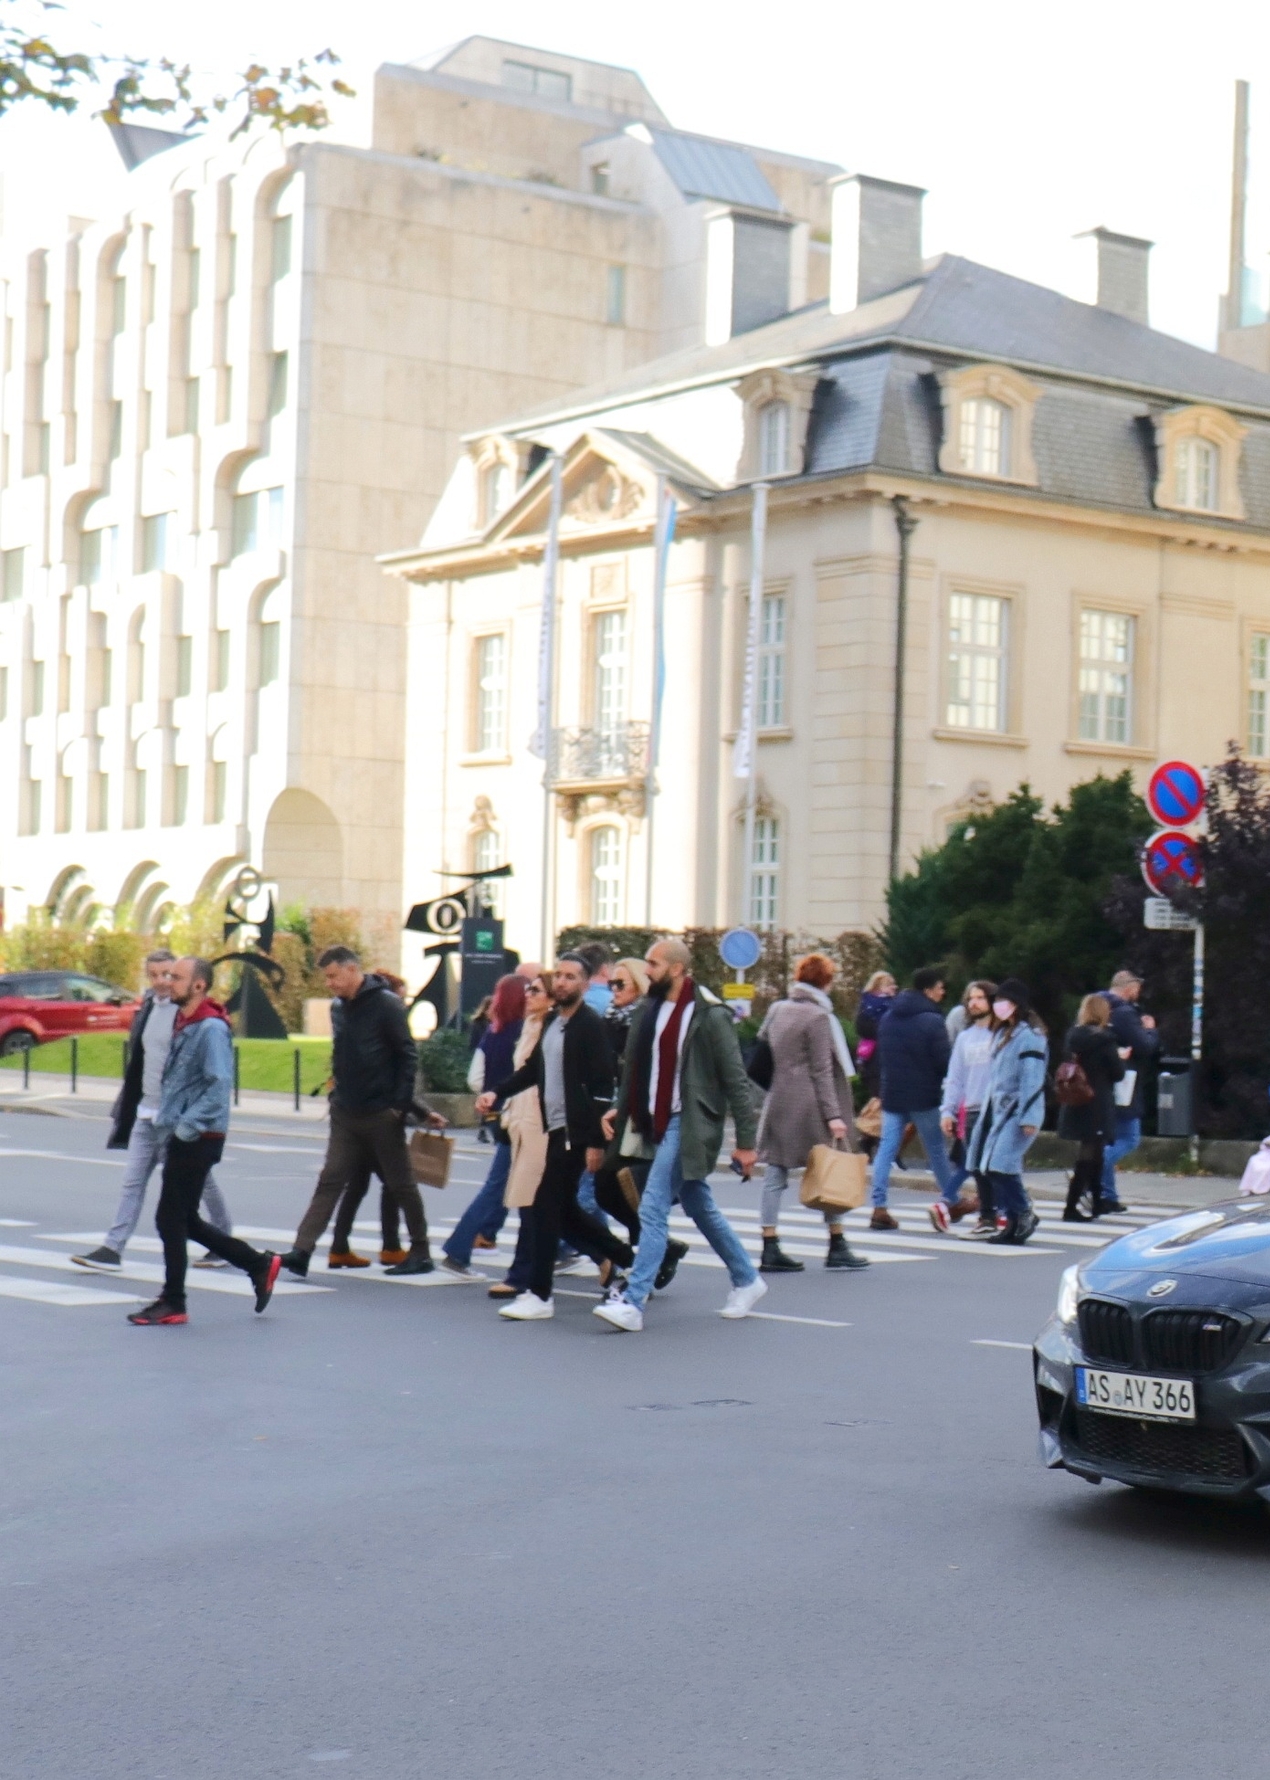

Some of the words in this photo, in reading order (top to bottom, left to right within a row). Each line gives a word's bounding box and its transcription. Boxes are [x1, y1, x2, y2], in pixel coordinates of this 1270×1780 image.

[1089, 1373, 1110, 1403] AS
[1125, 1378, 1147, 1408] AY
[1152, 1381, 1191, 1412] 366
